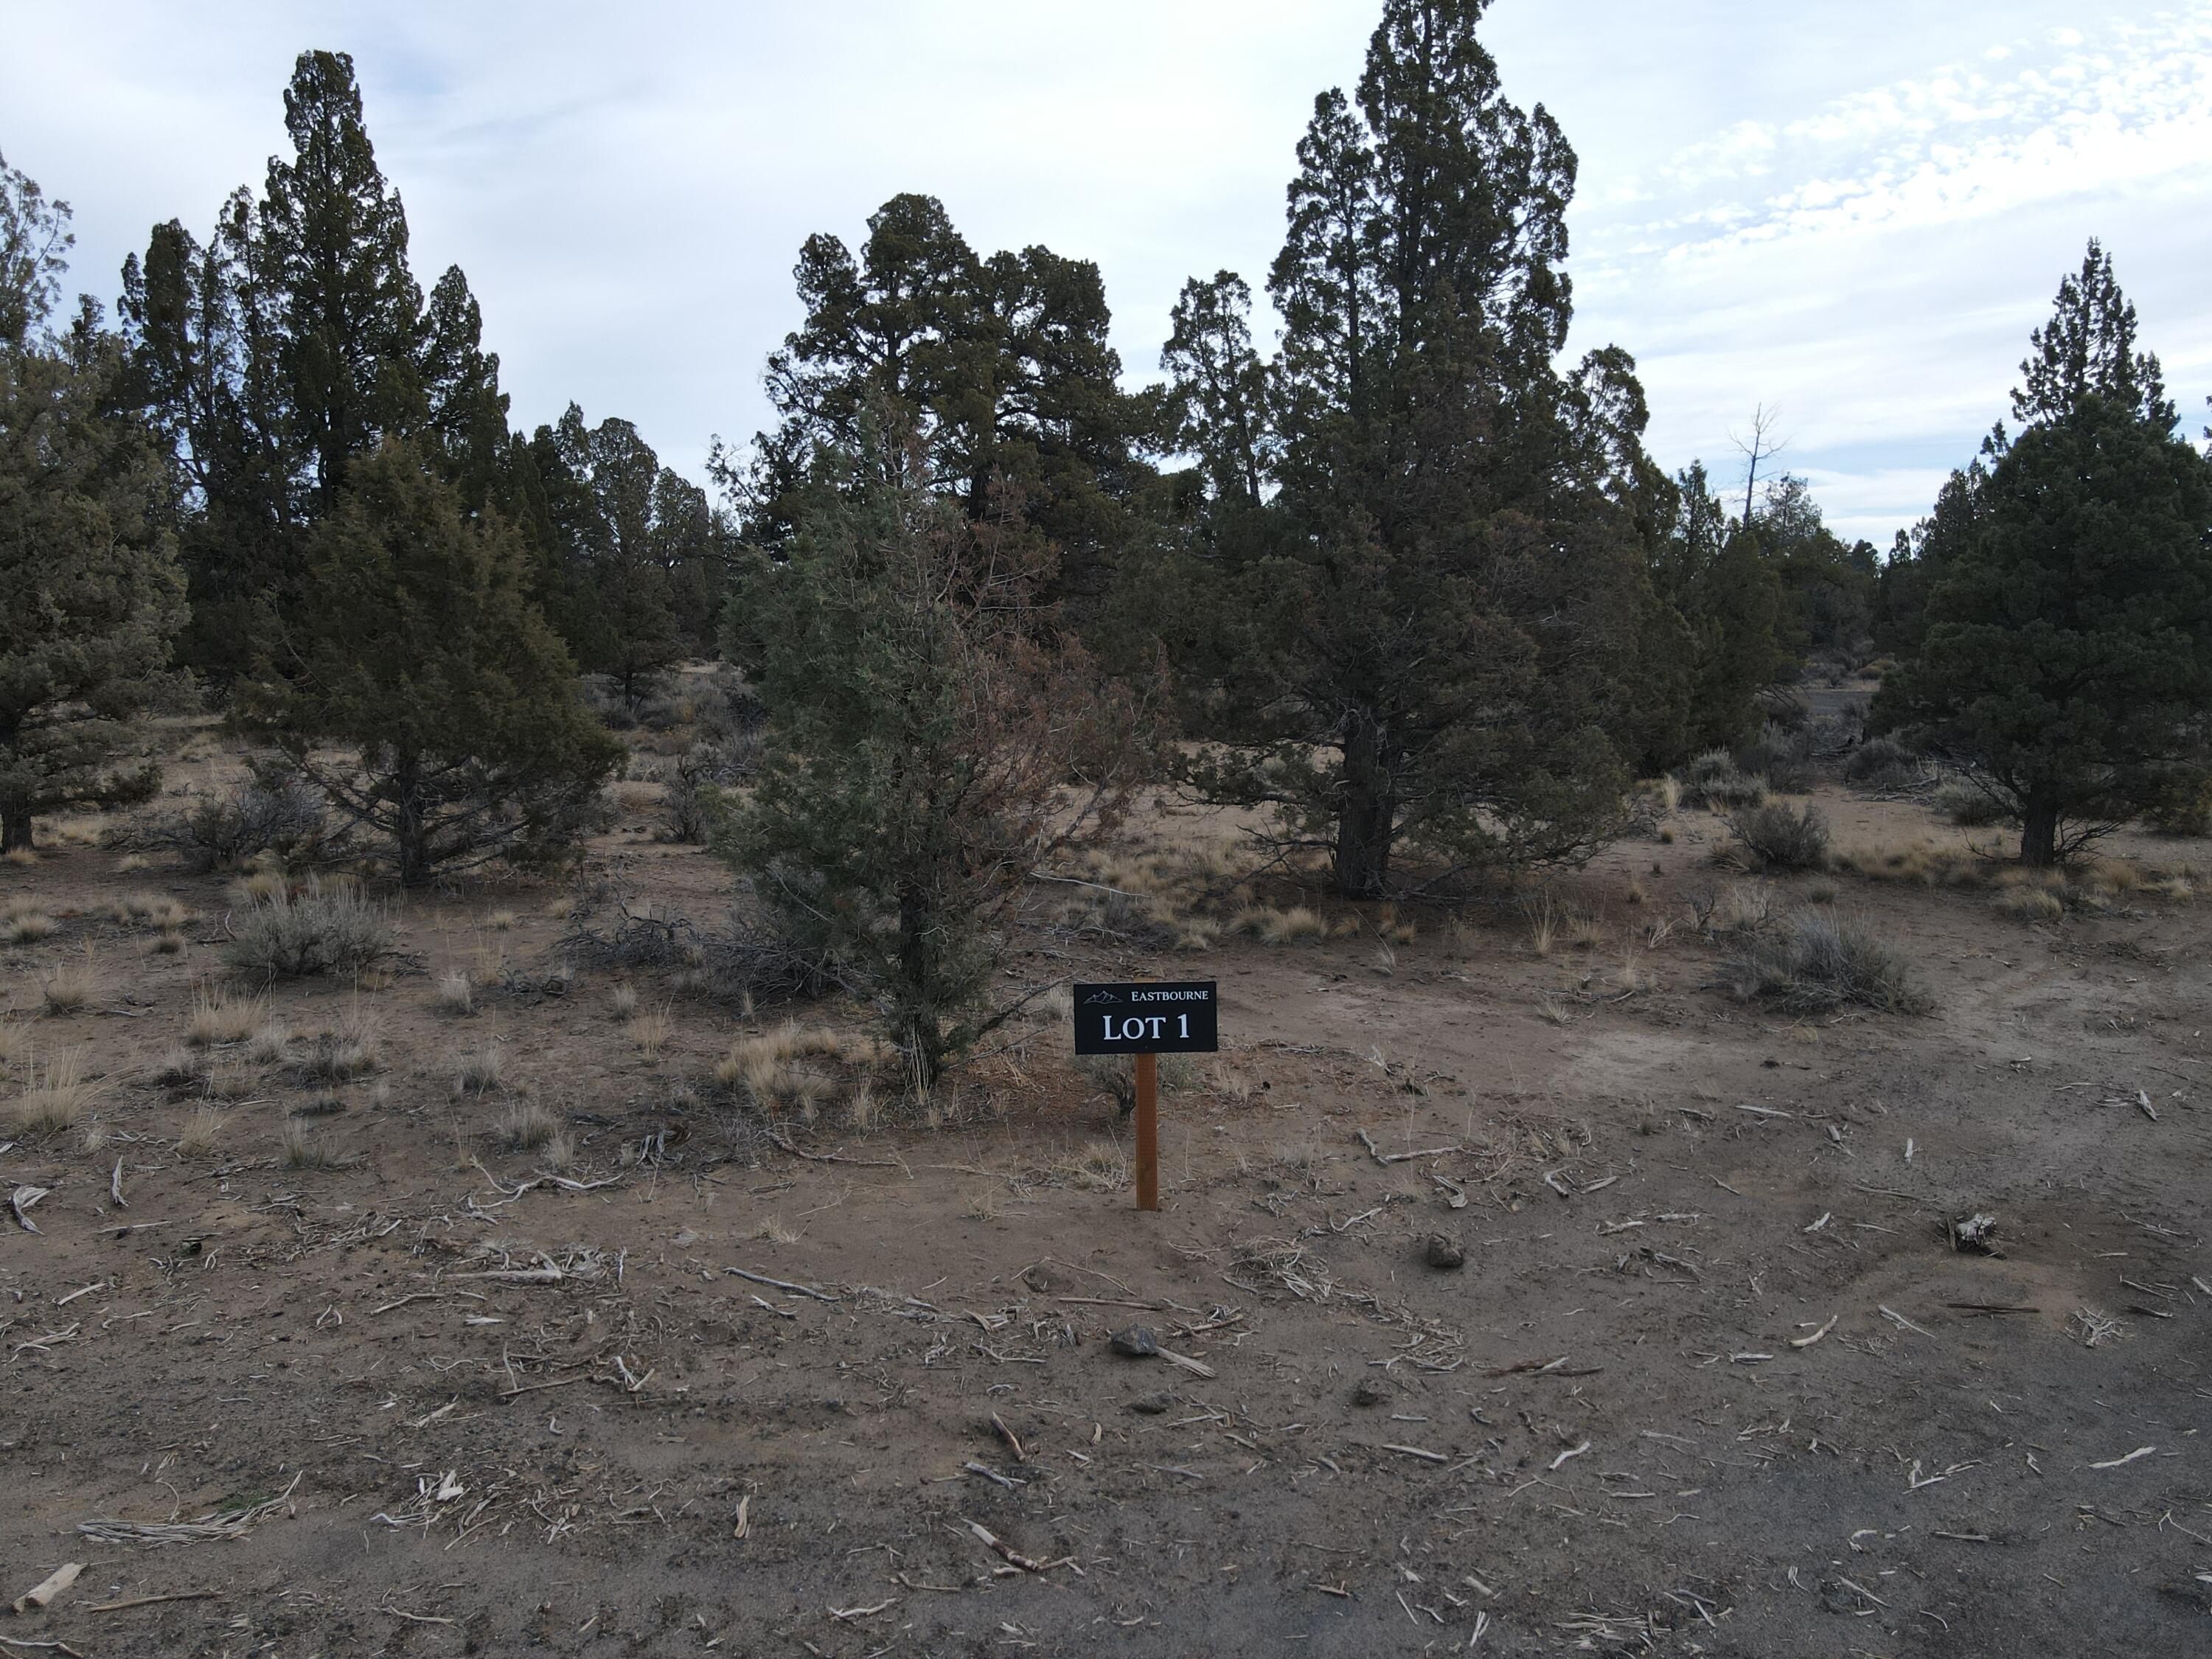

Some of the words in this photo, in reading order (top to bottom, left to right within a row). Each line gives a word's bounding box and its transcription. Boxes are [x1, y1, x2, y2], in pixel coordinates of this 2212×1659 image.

[1131, 990, 1209, 1001] EASTBOURNE
[1102, 1015, 1166, 1040] LOT
[1177, 1013, 1189, 1038] 1
